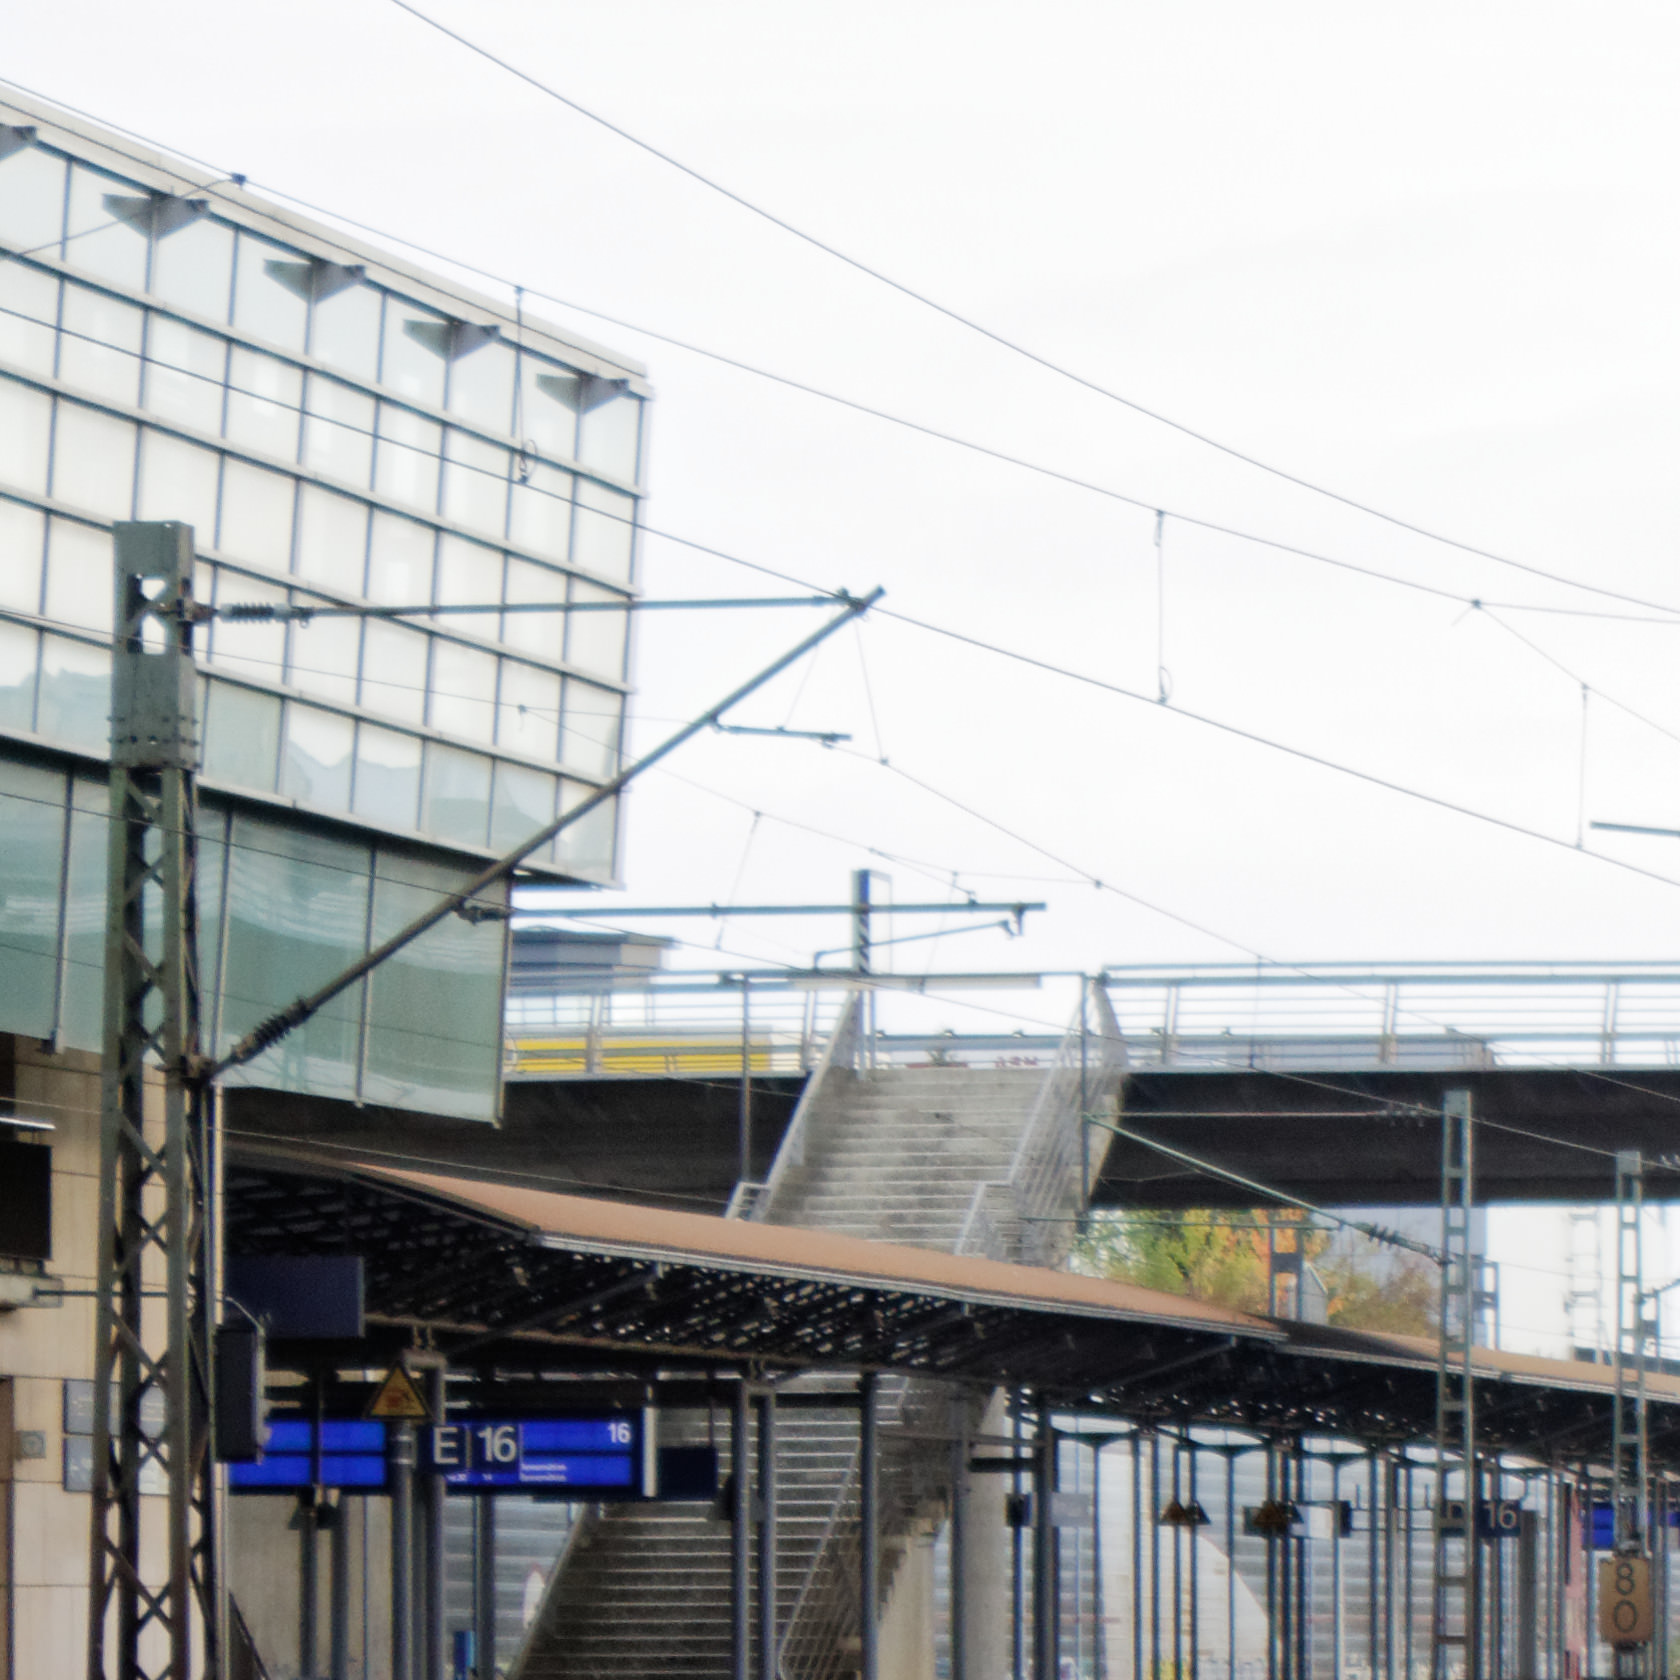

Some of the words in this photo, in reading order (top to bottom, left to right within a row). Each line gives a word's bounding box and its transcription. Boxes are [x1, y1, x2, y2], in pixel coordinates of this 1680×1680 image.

[433, 1427, 459, 1464] E
[477, 1426, 517, 1462] 16
[608, 1422, 632, 1444] 16
[1483, 1501, 1517, 1529] 16
[1615, 1562, 1635, 1596] 8
